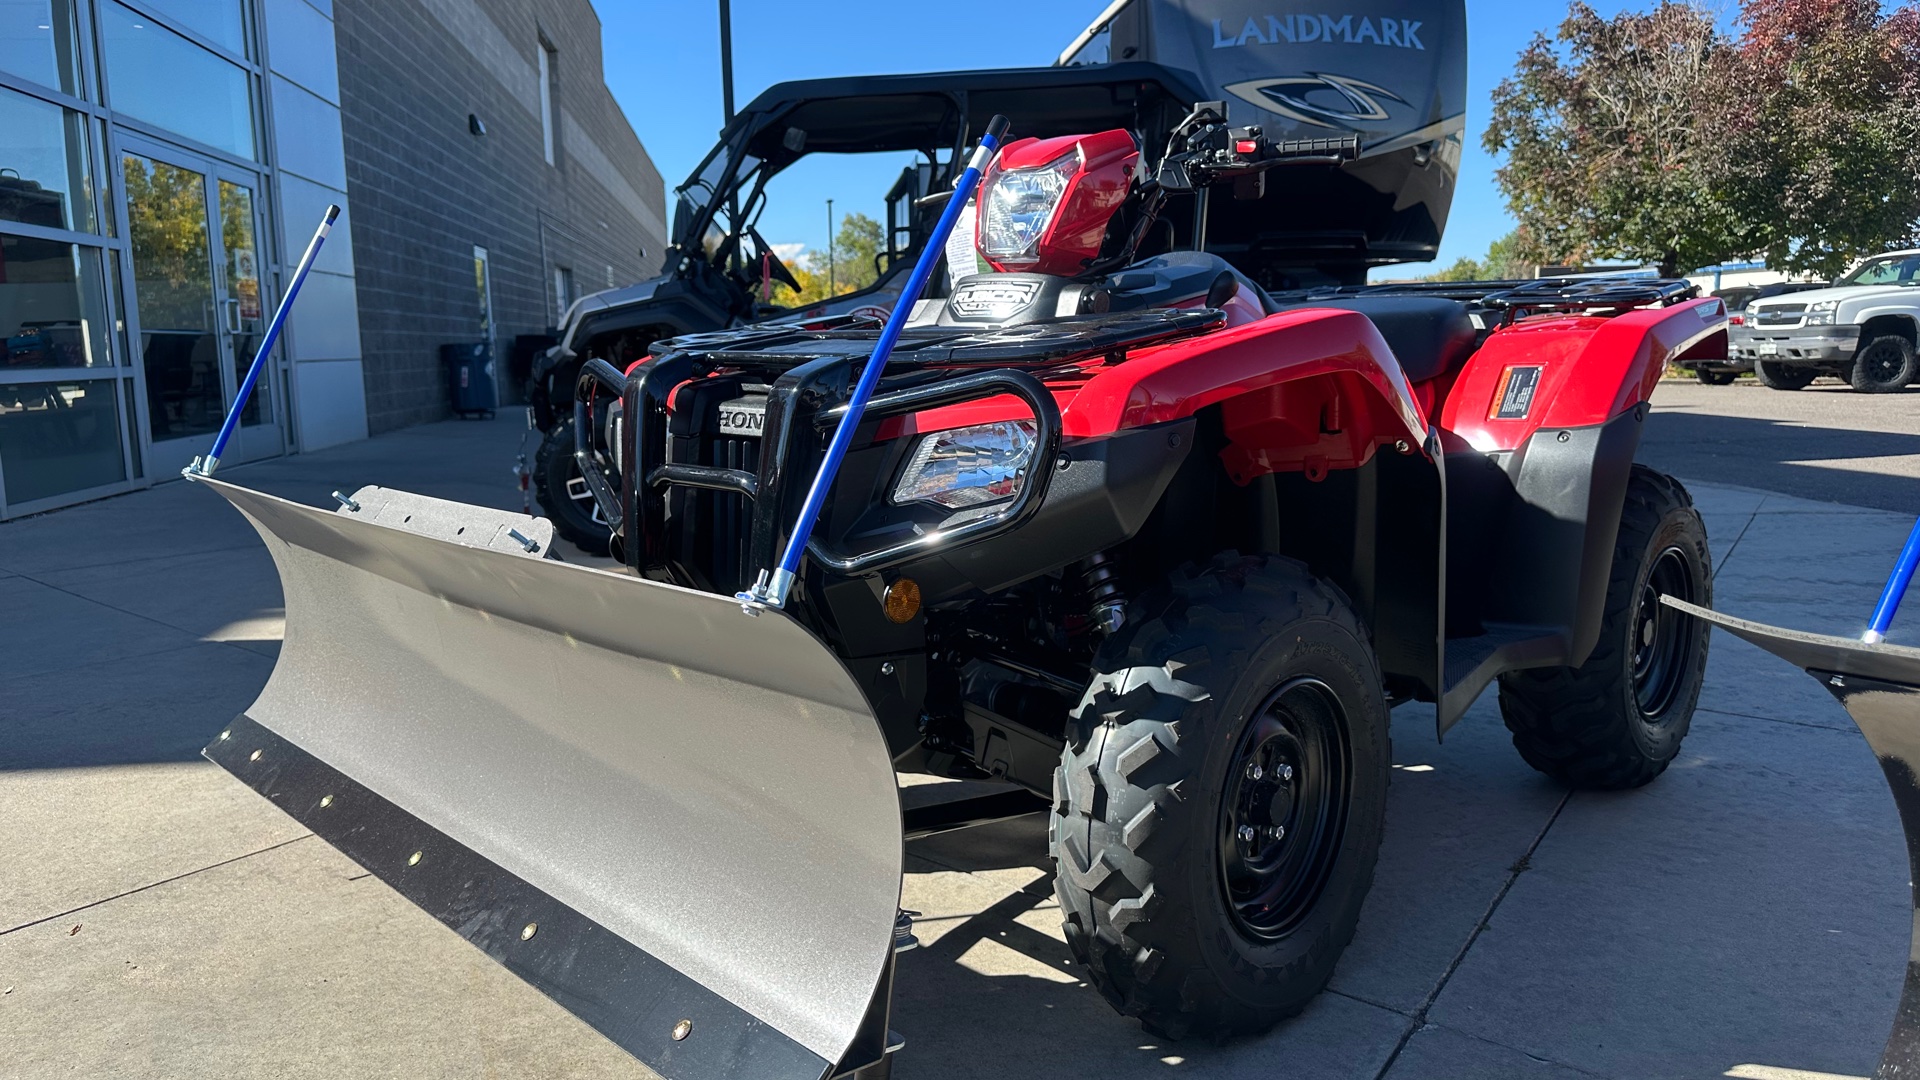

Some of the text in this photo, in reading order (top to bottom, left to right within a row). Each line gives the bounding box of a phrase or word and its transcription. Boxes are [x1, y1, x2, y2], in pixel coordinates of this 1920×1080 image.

[1212, 14, 1425, 50] LANDMARK
[953, 289, 1034, 304] RUBICON
[718, 410, 766, 430] HON
